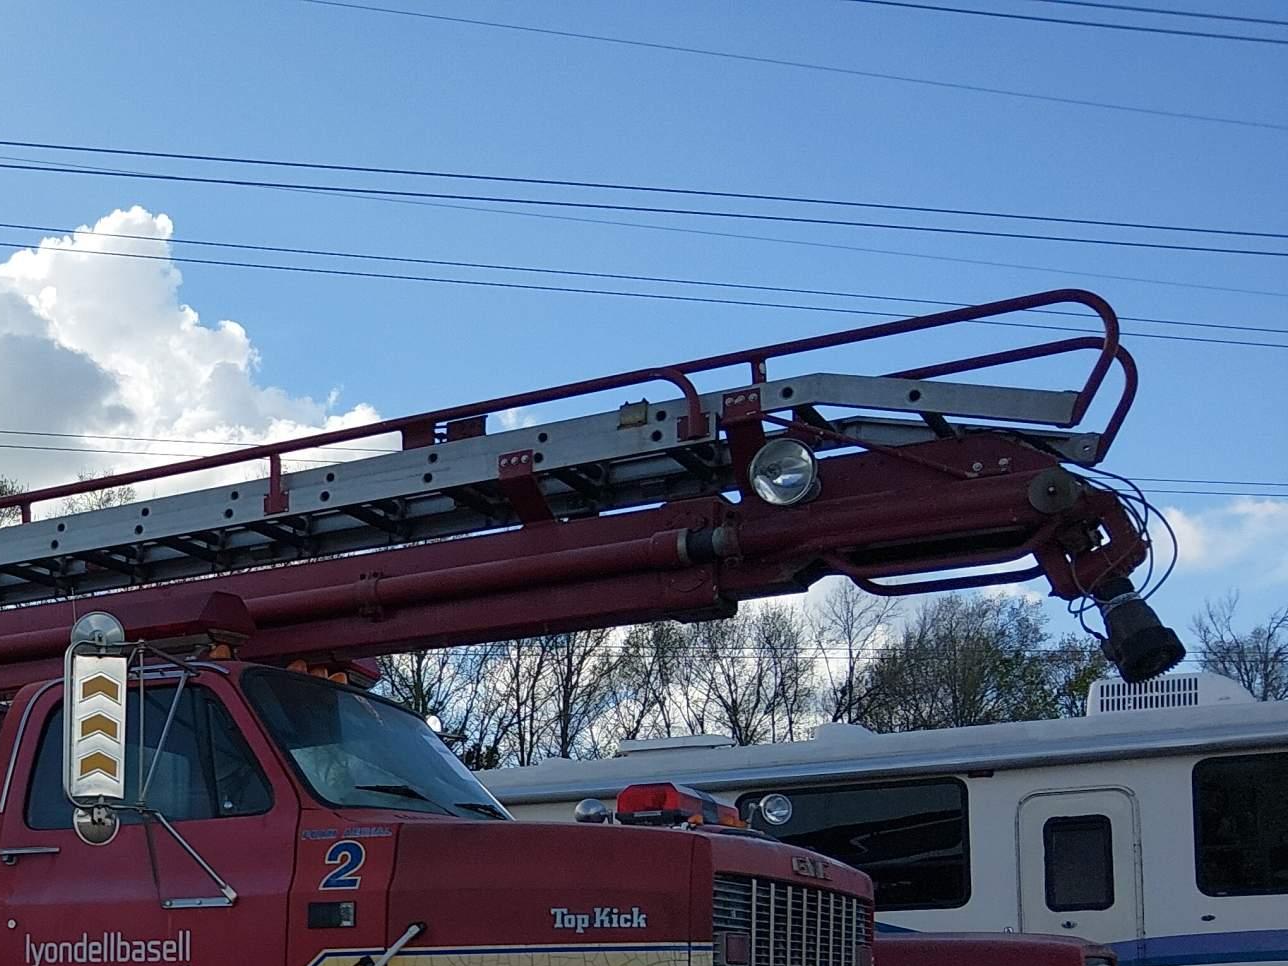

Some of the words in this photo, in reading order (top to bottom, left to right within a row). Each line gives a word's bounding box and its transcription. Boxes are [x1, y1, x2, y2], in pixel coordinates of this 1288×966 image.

[318, 839, 366, 891] 2
[550, 907, 590, 934] Top
[593, 905, 647, 929] Kick
